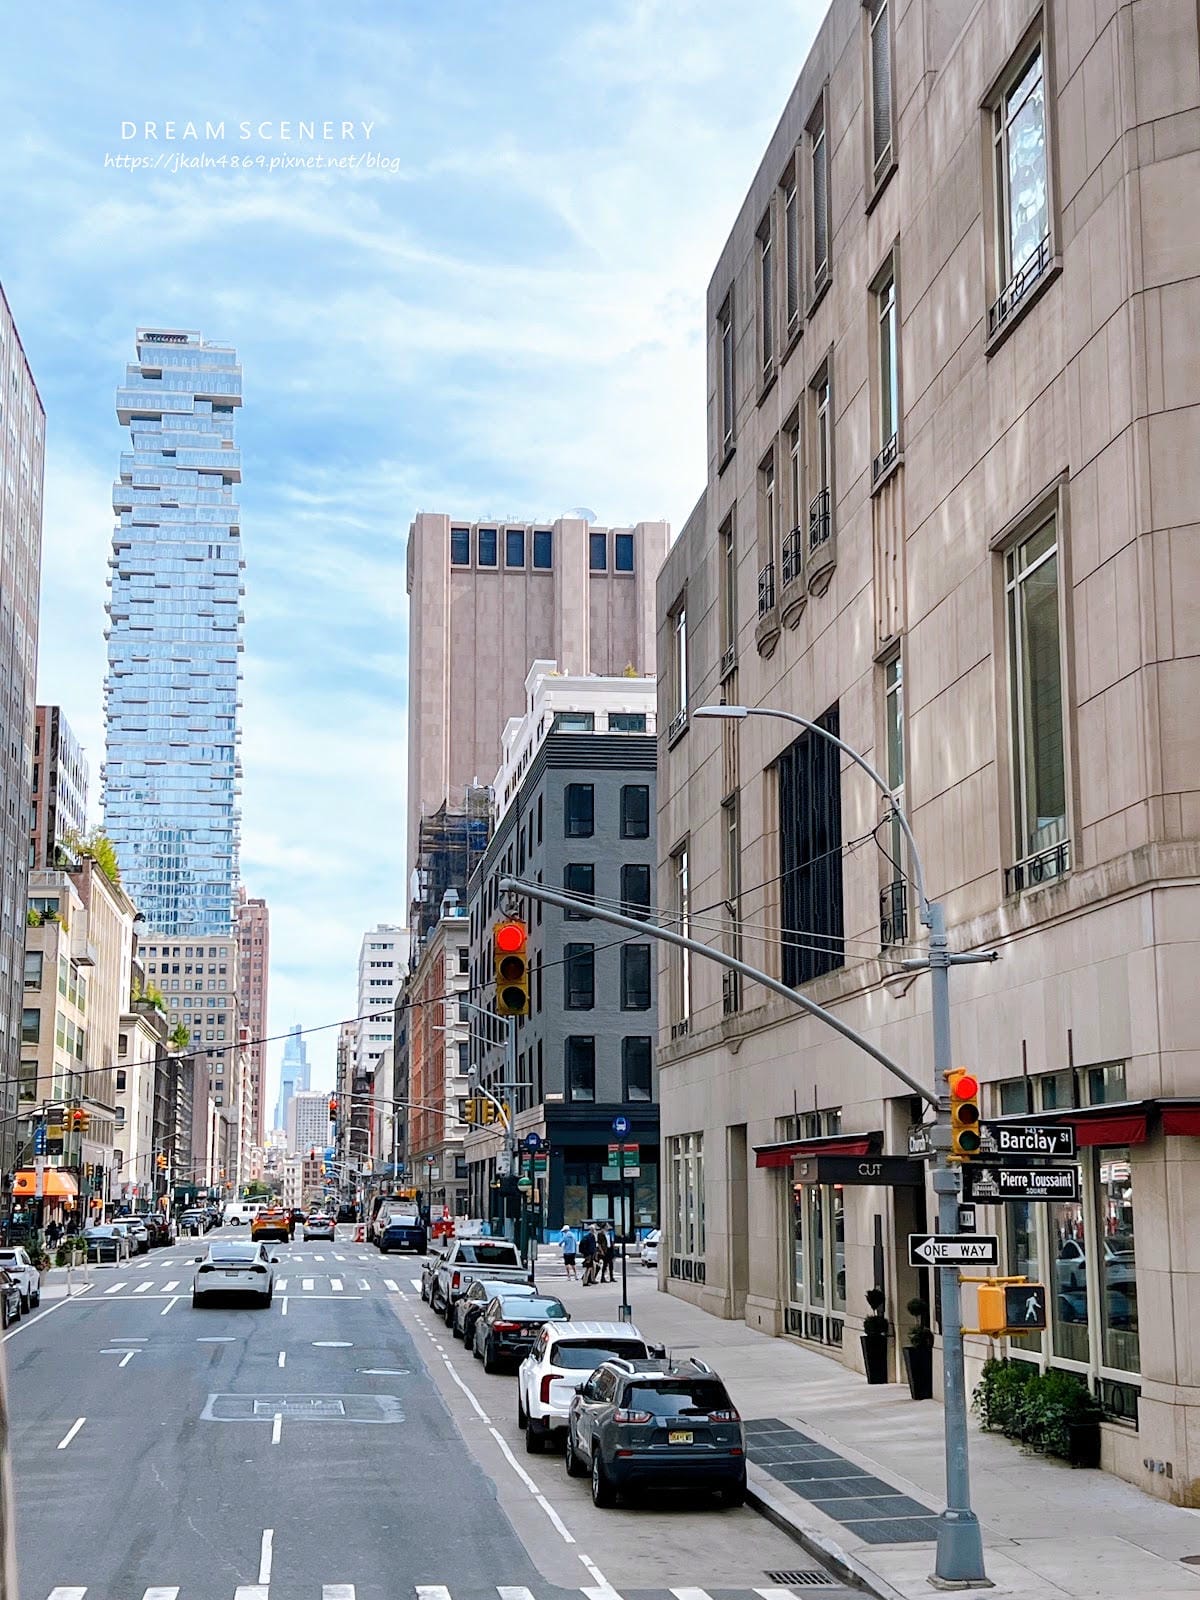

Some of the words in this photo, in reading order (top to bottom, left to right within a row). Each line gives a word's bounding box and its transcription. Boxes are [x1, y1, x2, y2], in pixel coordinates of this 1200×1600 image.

[1000, 1131, 1057, 1153] Barclay
[1060, 1132, 1069, 1142] St
[858, 1163, 883, 1176] CUT
[1000, 1172, 1028, 1187] Pierre
[1030, 1172, 1072, 1187] Toussaint
[1026, 1187, 1048, 1195] SQUARE
[924, 1245, 949, 1257] ONE
[960, 1245, 986, 1257] WAY
